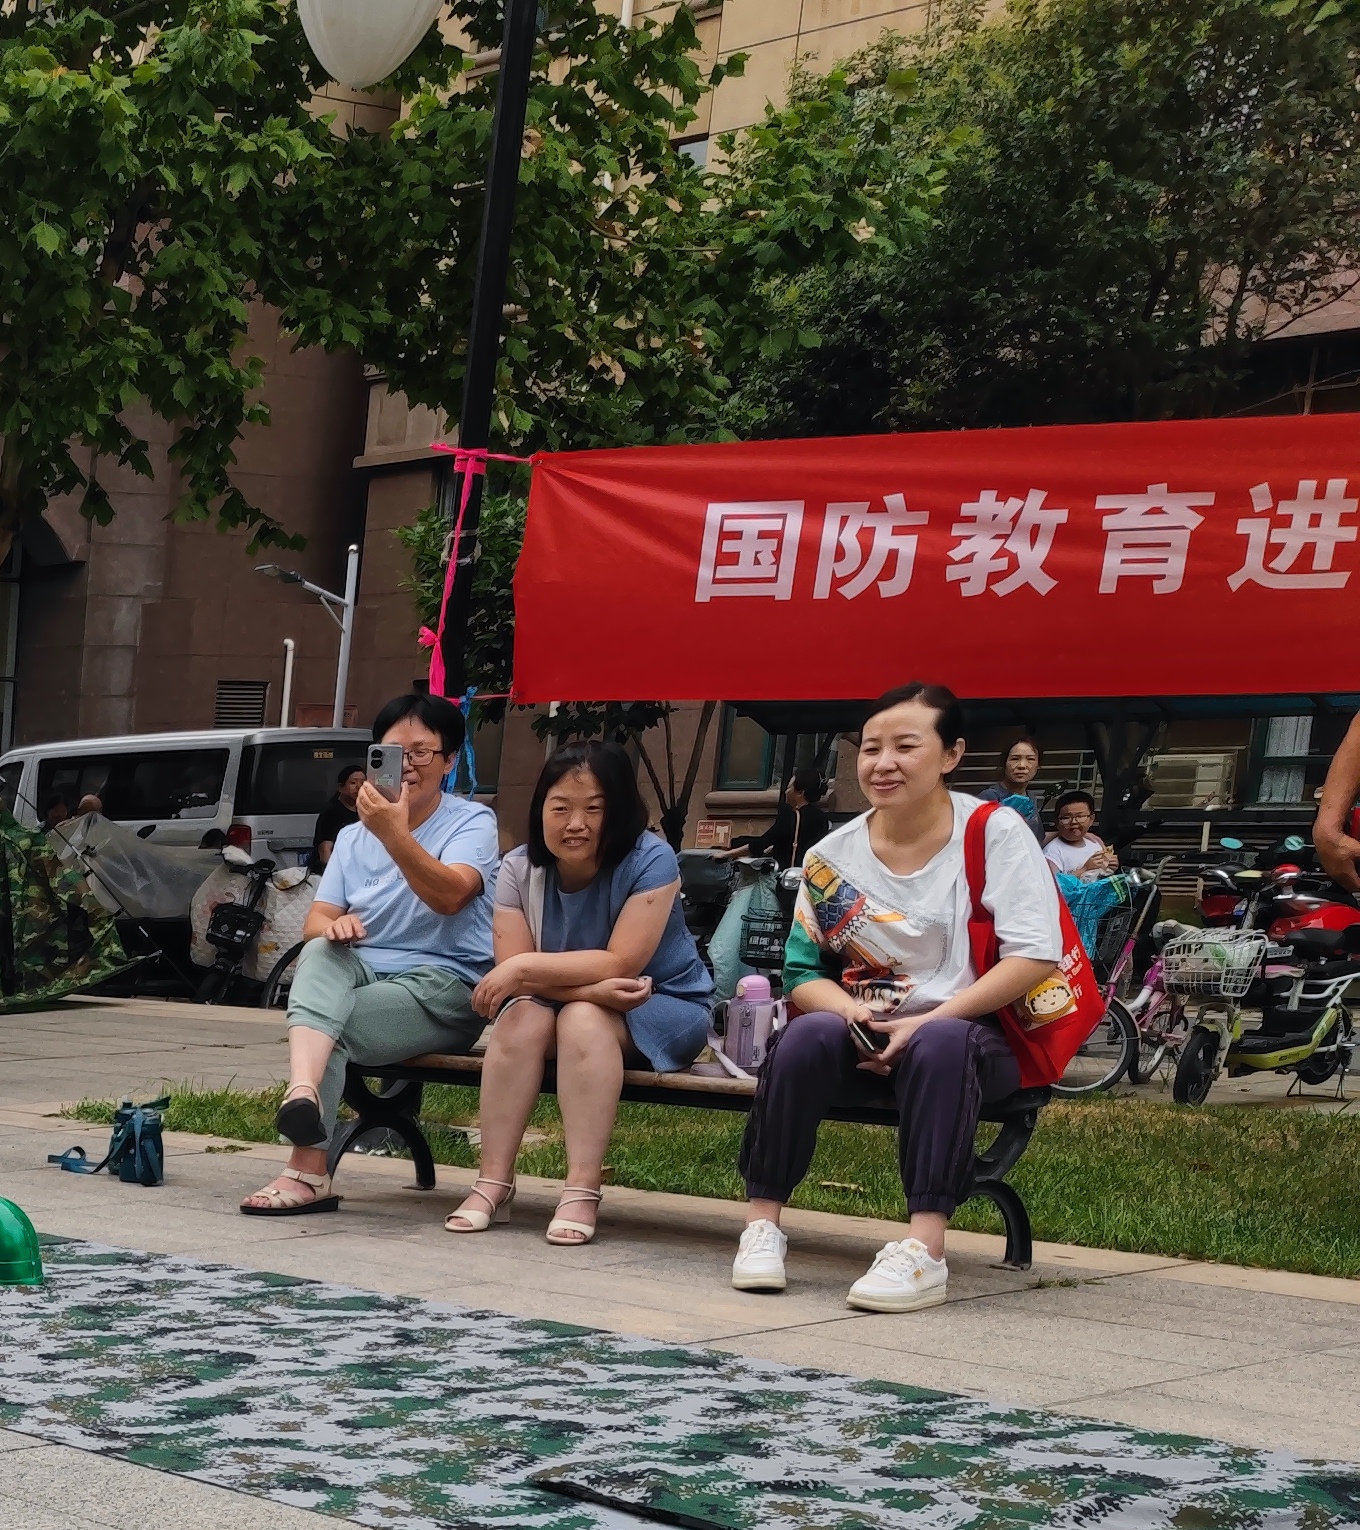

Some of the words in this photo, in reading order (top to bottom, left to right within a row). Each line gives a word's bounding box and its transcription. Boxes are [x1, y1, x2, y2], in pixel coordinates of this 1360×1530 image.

[695, 477, 1360, 603] 国防教育进
